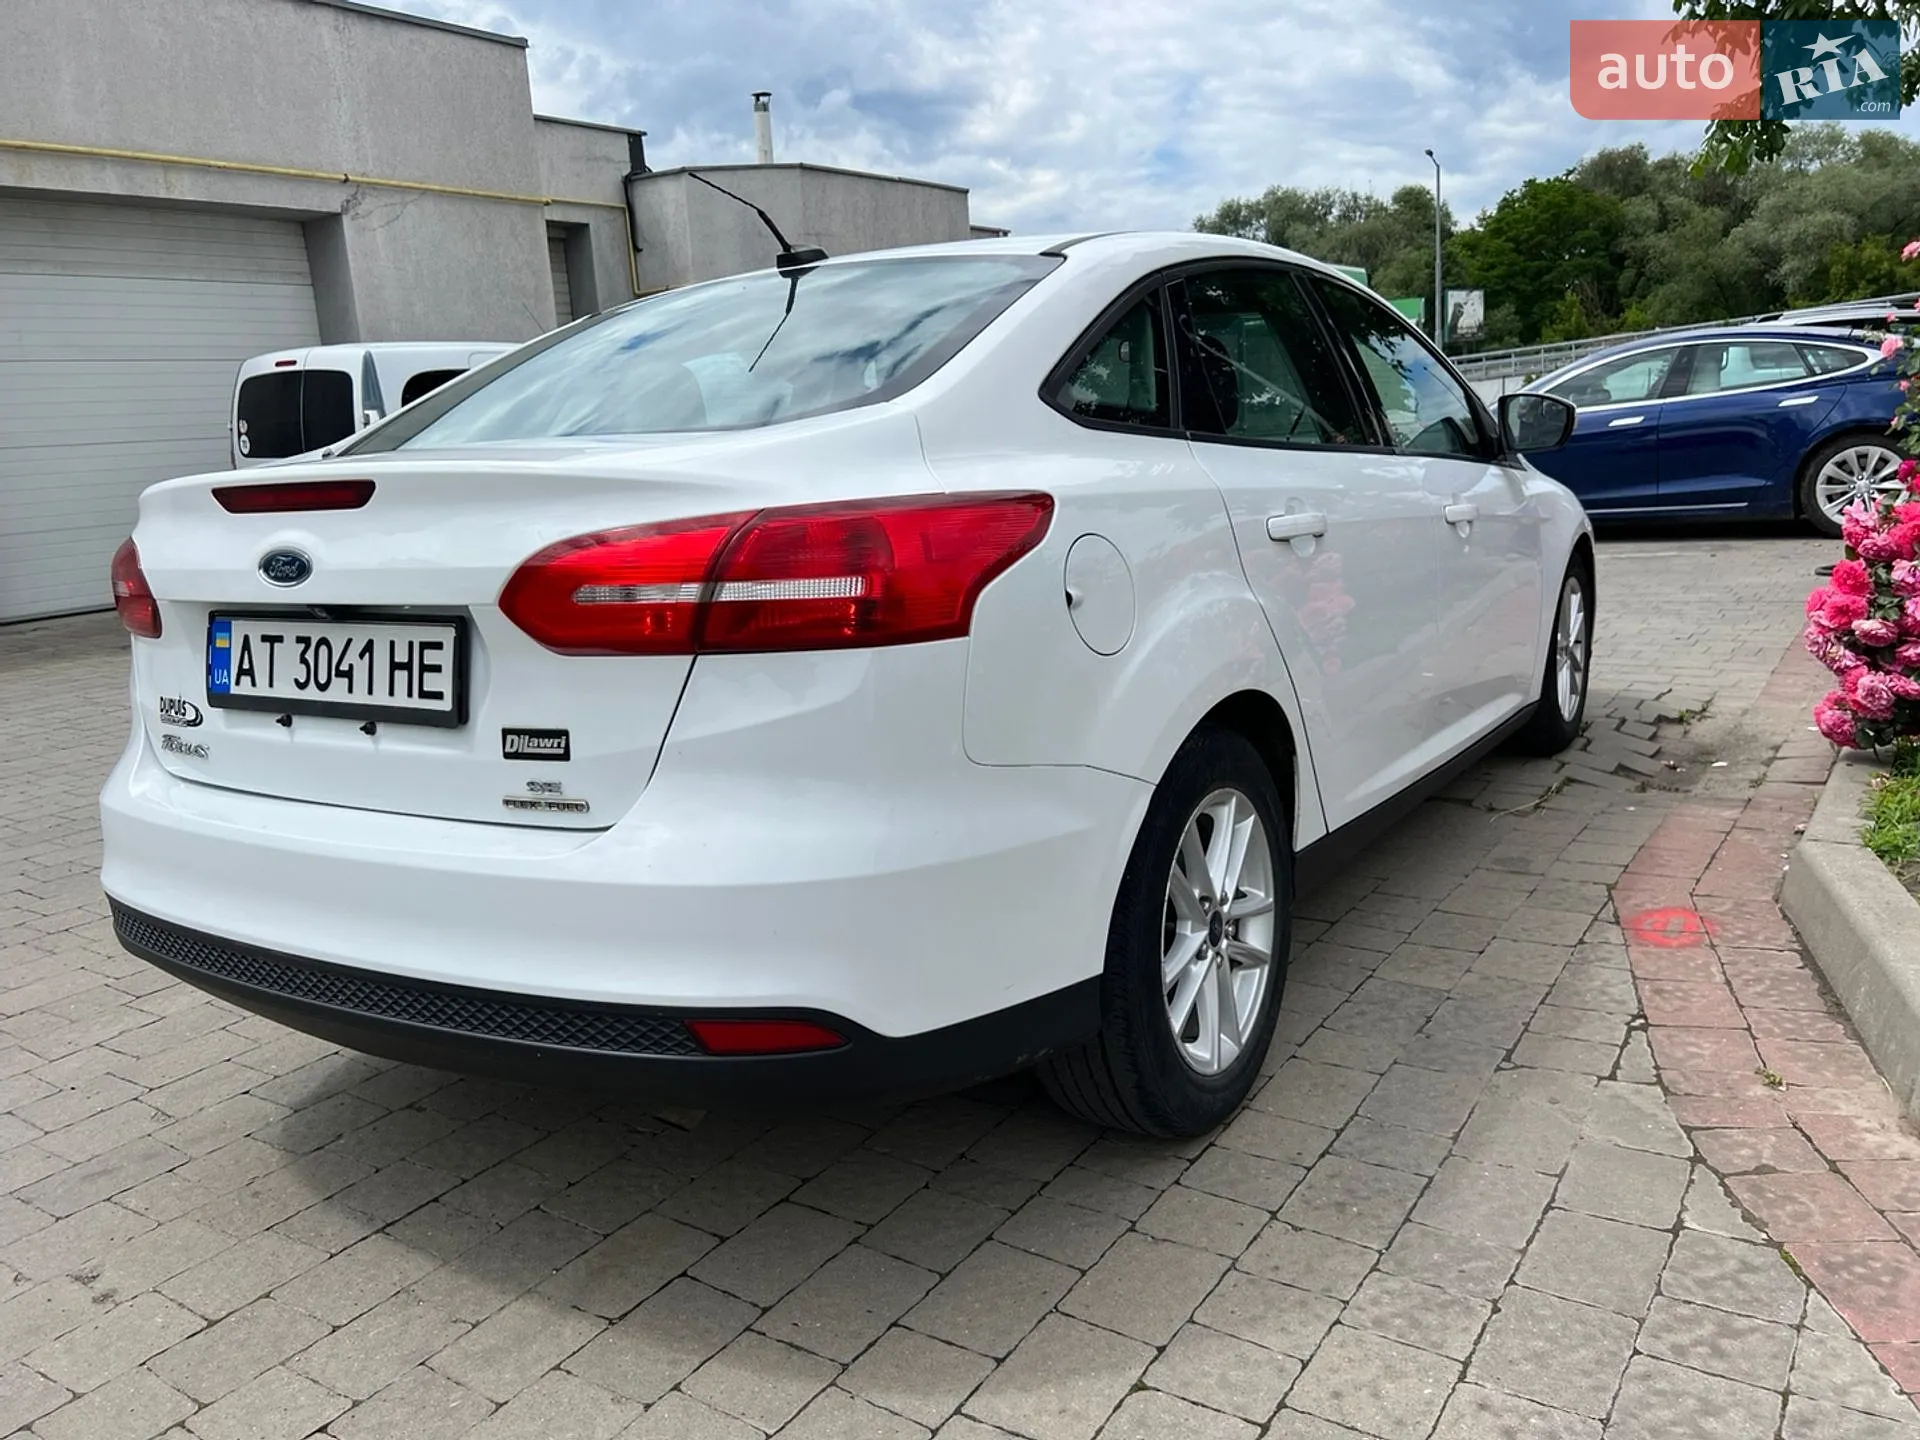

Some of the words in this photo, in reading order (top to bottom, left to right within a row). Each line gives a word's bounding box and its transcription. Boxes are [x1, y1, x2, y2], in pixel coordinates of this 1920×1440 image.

[268, 554, 300, 578] Ford
[214, 668, 230, 685] UA
[235, 634, 284, 688] AT
[294, 635, 375, 696] 3041
[388, 640, 444, 700] HE
[526, 781, 563, 795] SE
